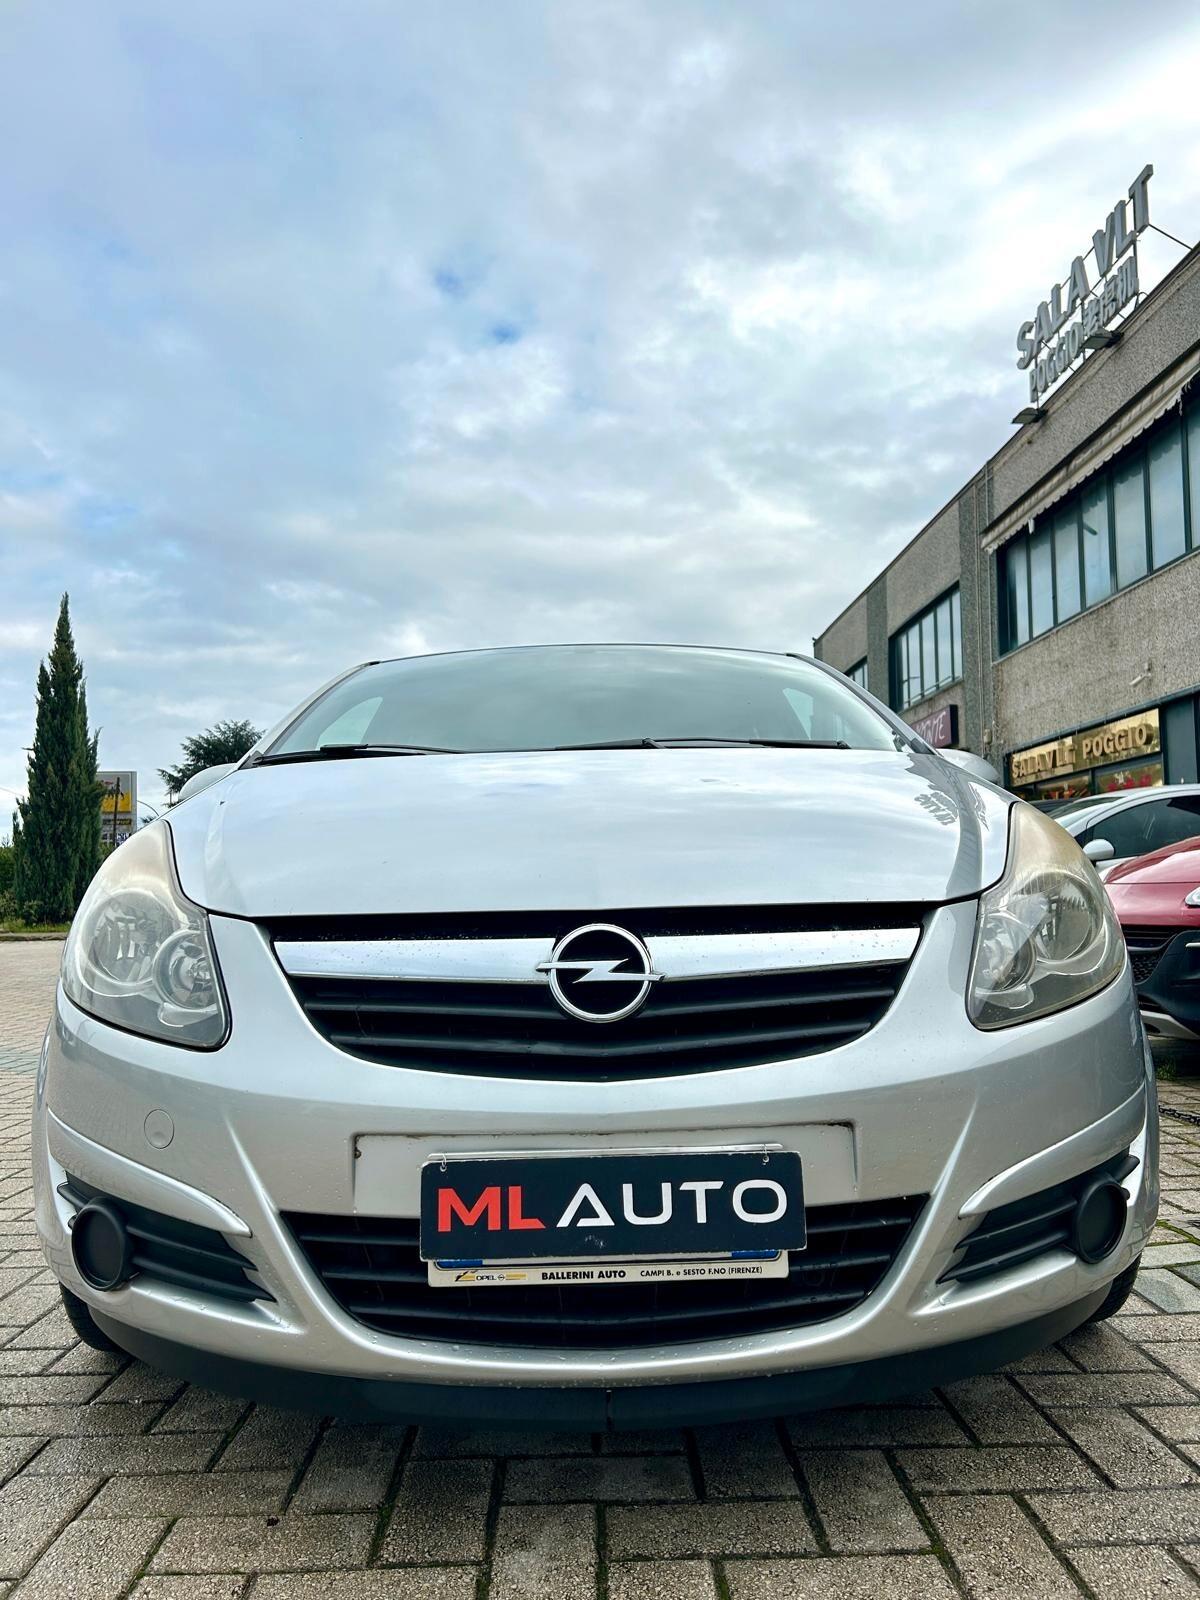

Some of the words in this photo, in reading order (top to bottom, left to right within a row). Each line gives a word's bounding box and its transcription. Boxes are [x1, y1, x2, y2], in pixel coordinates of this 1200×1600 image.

[1016, 256, 1091, 370] SALA
[1092, 164, 1153, 278] VLT
[1029, 322, 1084, 403] POGGIO
[1012, 752, 1047, 778] SALA
[1082, 724, 1151, 760] POGGIO
[437, 1185, 546, 1233] ML
[556, 1179, 787, 1229] AUTO
[541, 1271, 594, 1281] BALLERINI
[597, 1270, 627, 1279] AUTO
[683, 1268, 706, 1276] SESTO
[708, 1267, 726, 1275] F.NO
[728, 1266, 763, 1275] (FIRENZE)
